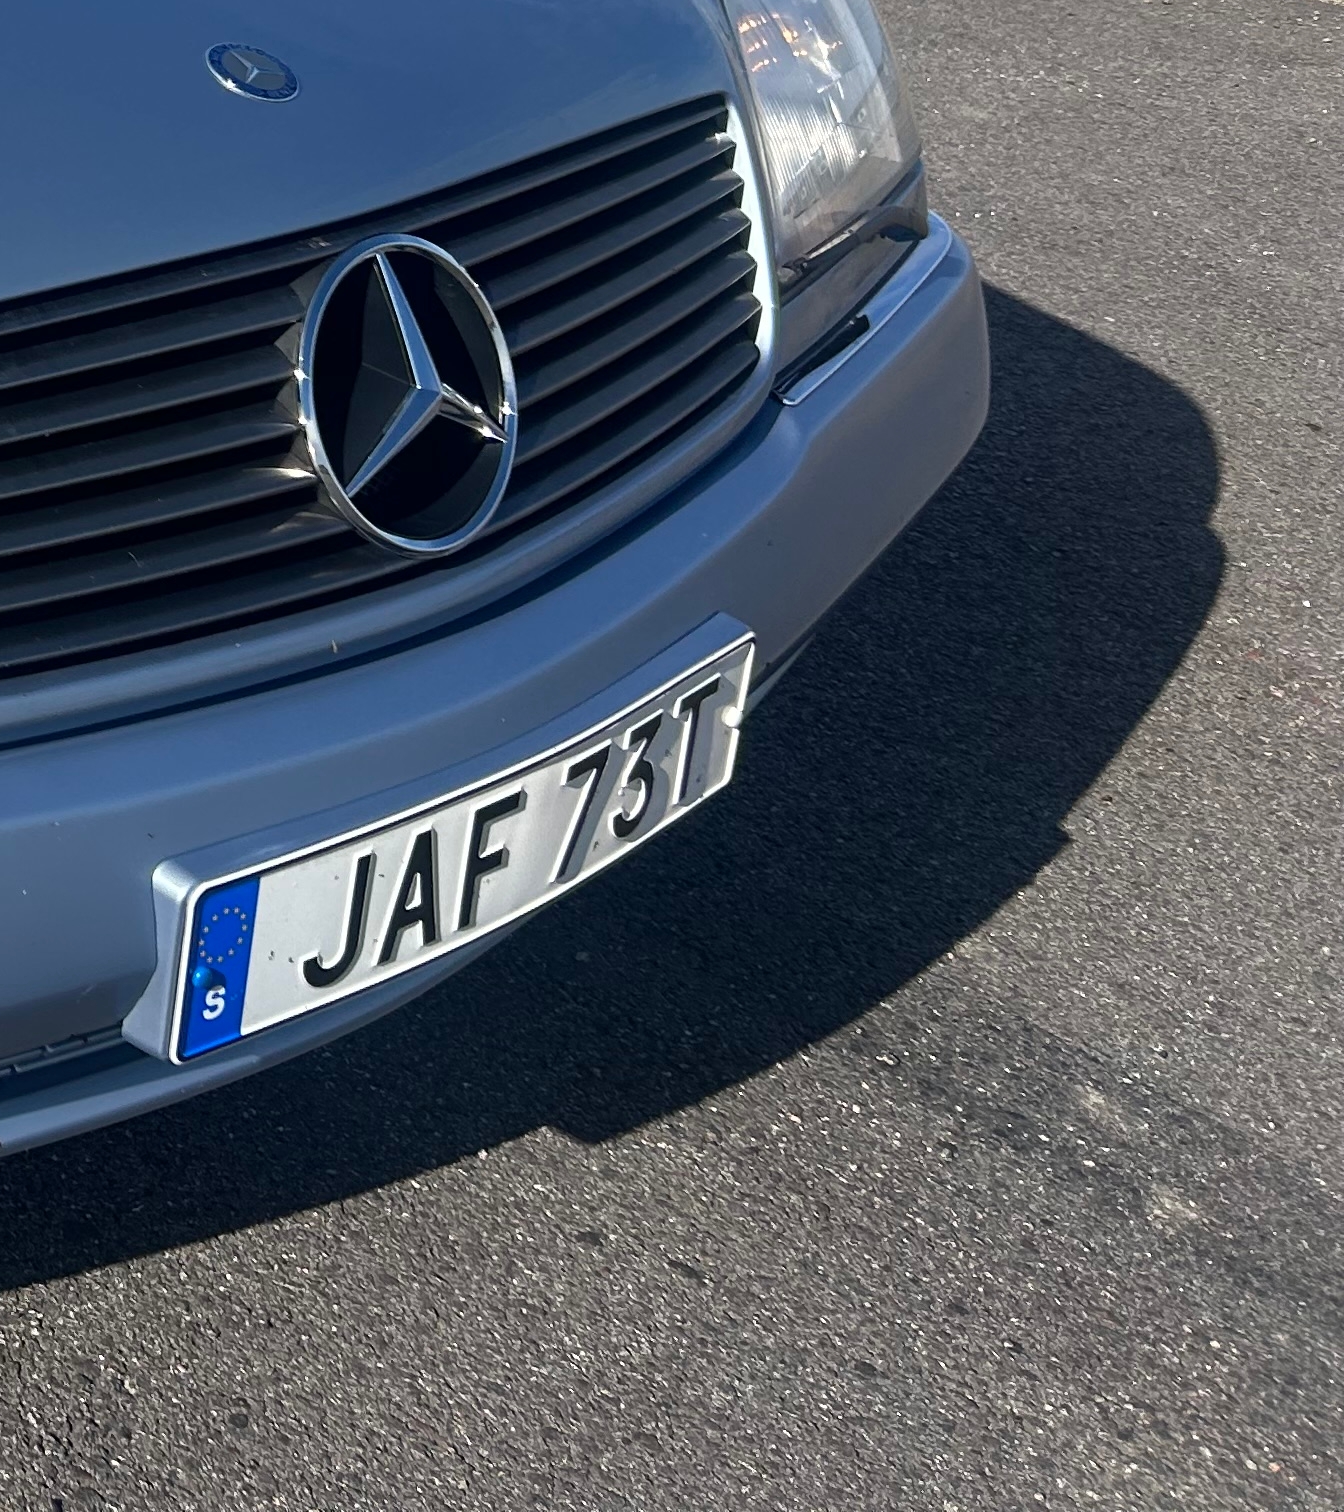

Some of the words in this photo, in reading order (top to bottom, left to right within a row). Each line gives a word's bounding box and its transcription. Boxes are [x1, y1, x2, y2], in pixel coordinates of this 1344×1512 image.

[300, 788, 525, 988] JAF
[550, 674, 720, 884] 73T
[202, 984, 227, 1021] S
